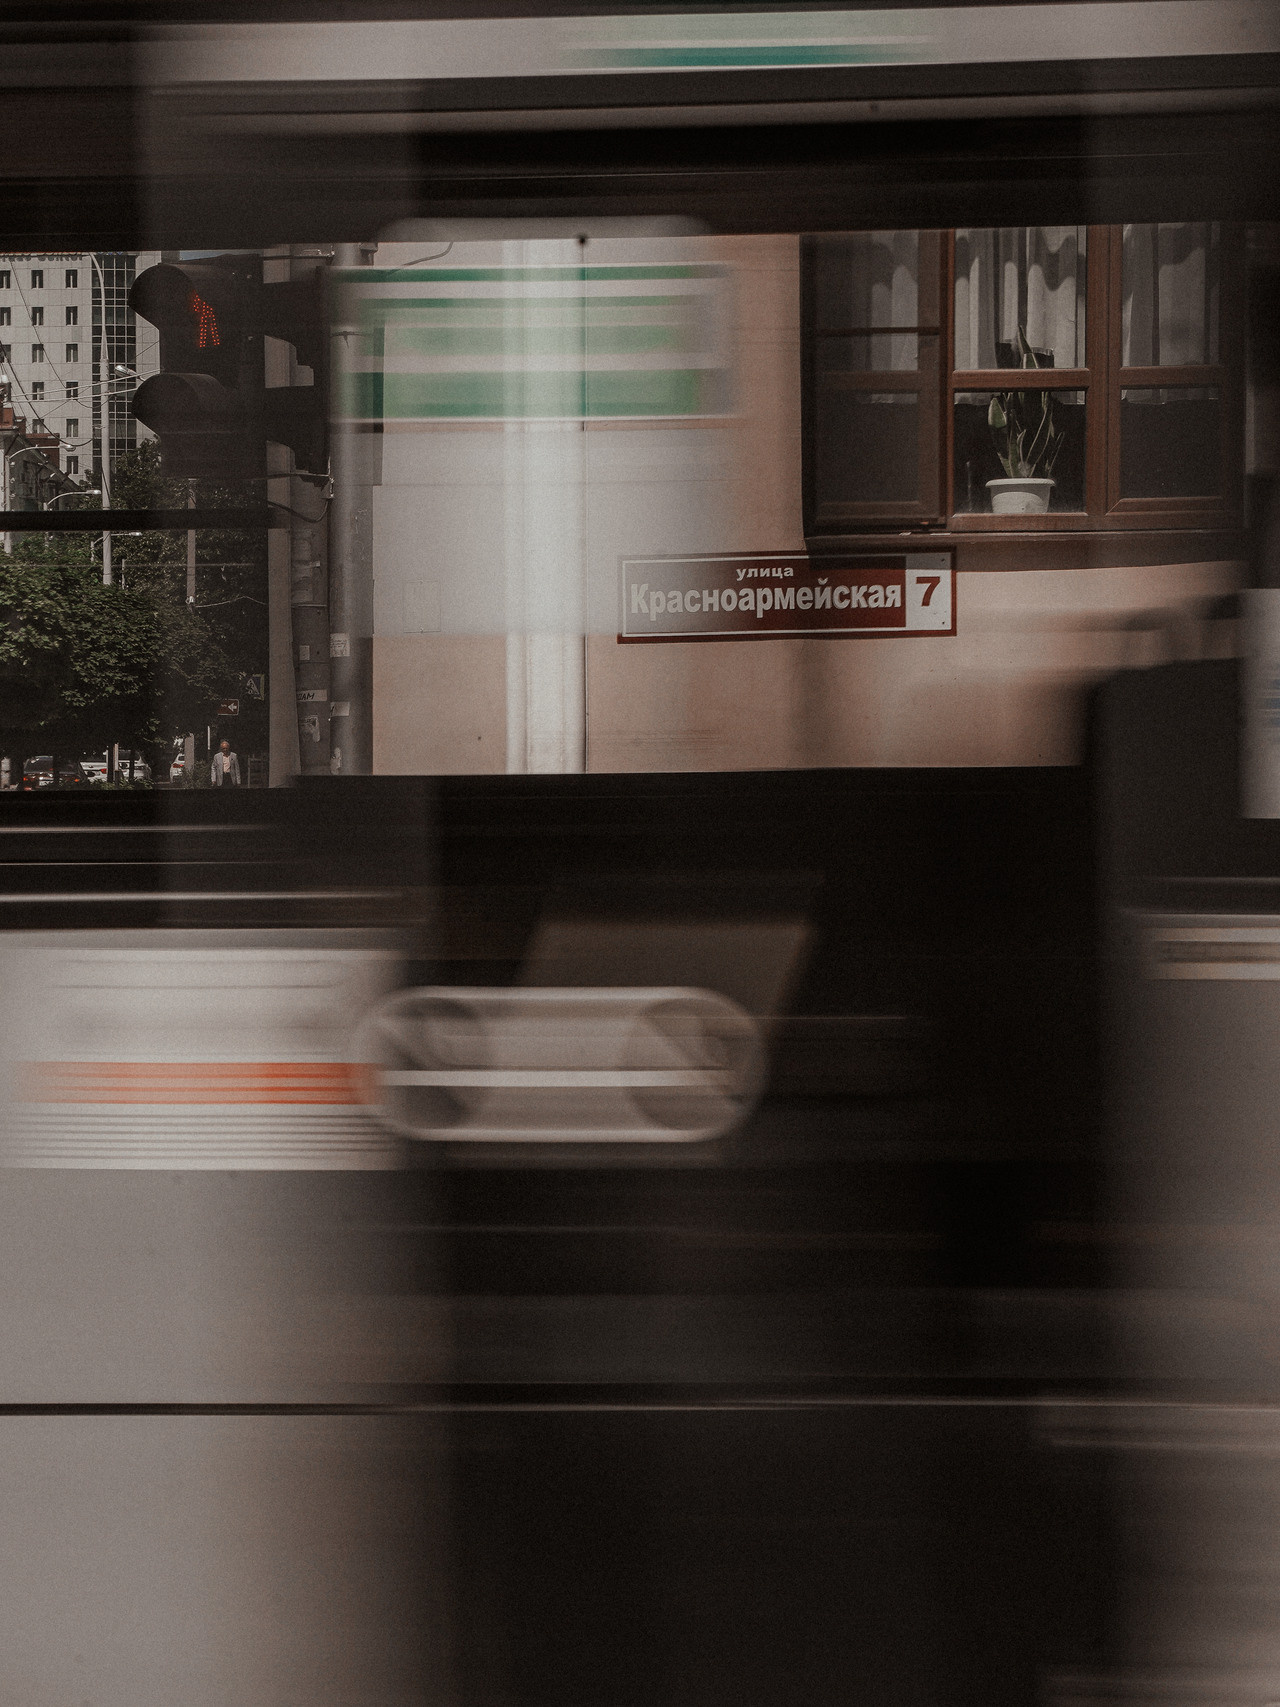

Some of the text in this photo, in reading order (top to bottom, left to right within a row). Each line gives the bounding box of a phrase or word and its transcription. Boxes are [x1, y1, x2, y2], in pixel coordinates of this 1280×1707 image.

[736, 566, 794, 581] улица
[630, 577, 902, 622] Красноармейская
[915, 576, 941, 607] 7
